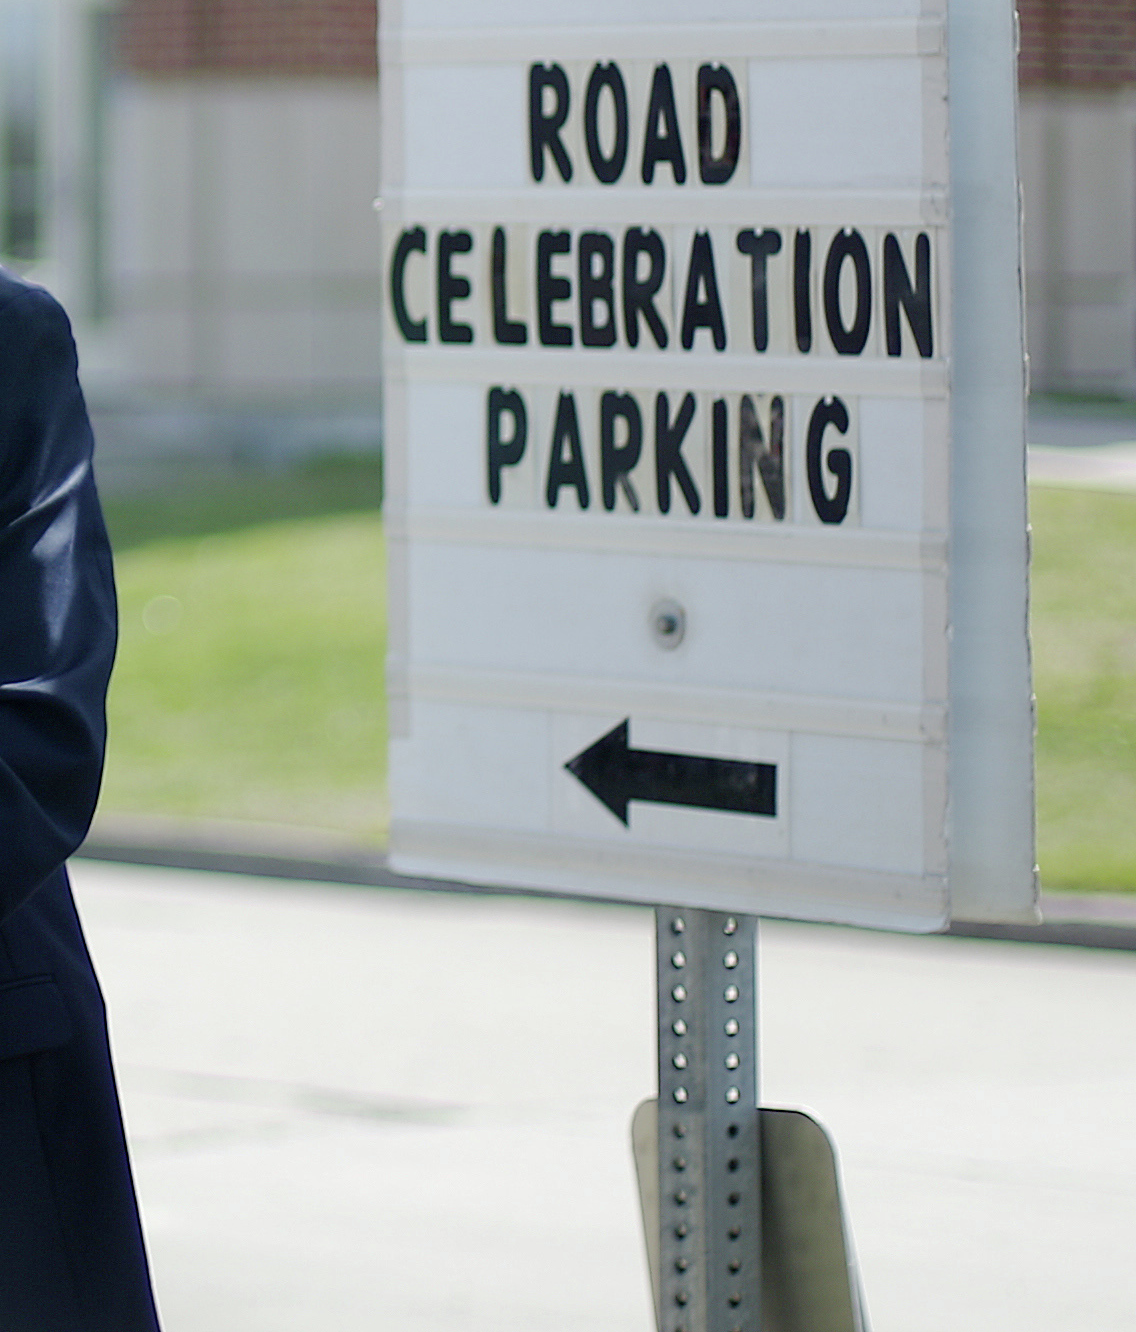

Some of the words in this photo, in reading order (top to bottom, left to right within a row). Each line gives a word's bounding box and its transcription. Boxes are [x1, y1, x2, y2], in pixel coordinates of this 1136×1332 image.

[528, 61, 742, 186] ROAD
[389, 225, 934, 360] CELEBRATION
[486, 386, 853, 526] PARKING
